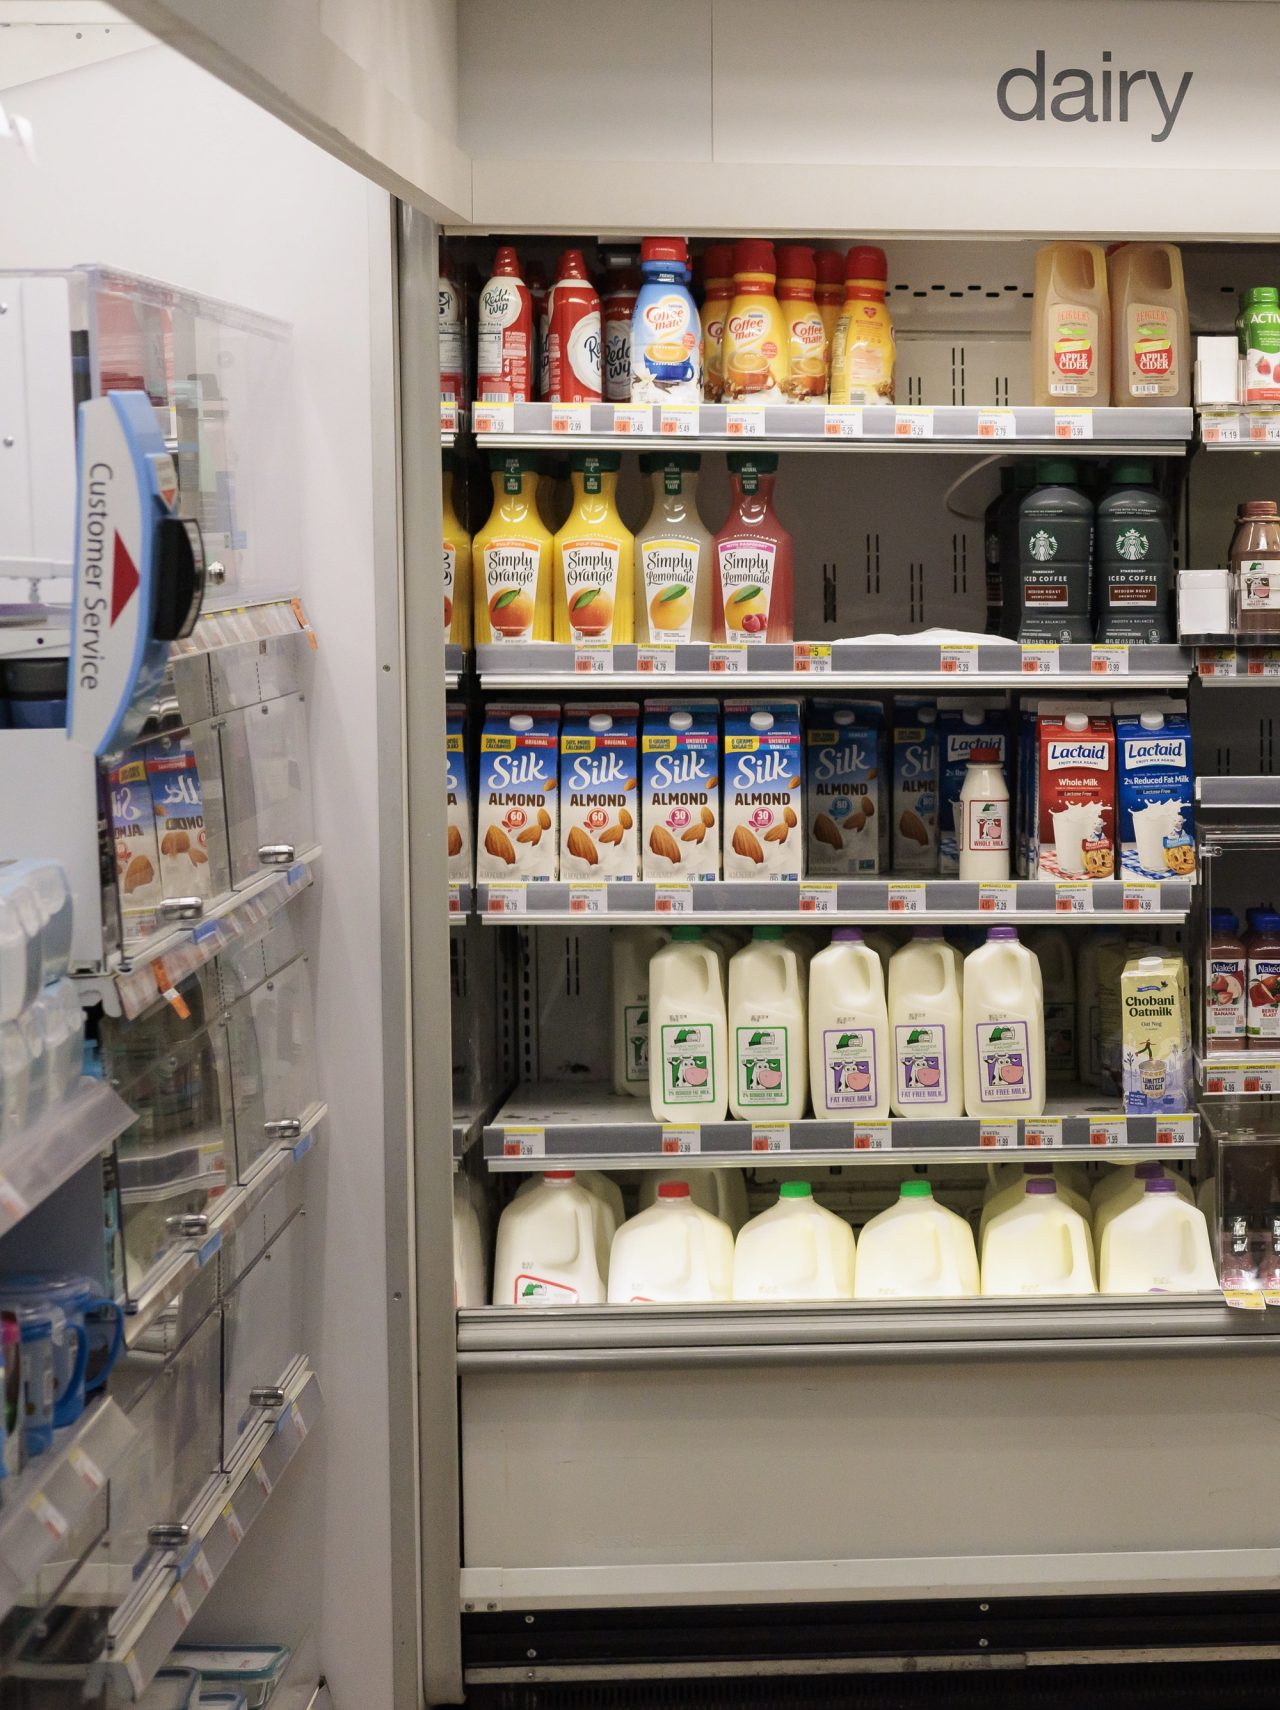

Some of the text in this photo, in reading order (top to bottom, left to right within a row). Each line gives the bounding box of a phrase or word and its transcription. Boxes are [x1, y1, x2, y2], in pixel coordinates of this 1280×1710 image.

[996, 50, 1194, 142] dairy
[729, 316, 764, 333] Coffee
[792, 321, 823, 338] Coffee
[1060, 353, 1087, 362] APPLE
[1140, 353, 1167, 362] APPLE
[1059, 361, 1089, 370] CIDER
[1140, 361, 1168, 370] CIDER
[488, 550, 533, 573] Simply
[568, 550, 613, 573] Simply
[647, 551, 693, 573] Simply
[724, 551, 769, 573] Simply
[80, 463, 113, 690] Customer Service
[487, 567, 534, 586] Orange
[567, 568, 614, 586] Orange
[645, 570, 694, 587] Lemonade
[722, 570, 770, 587] Lemonade
[1051, 745, 1105, 760] Lactaid
[1128, 742, 1182, 758] Lactaid
[814, 744, 870, 780] Silk
[901, 746, 937, 779] Sil
[487, 752, 548, 791] Silk
[568, 752, 628, 791] Silk
[650, 751, 710, 790] Silk
[732, 751, 793, 790] Silk
[902, 780, 936, 793] ALMO
[1058, 778, 1098, 786] Whole Milk
[1124, 777, 1133, 785] 2%
[1134, 776, 1163, 785] Reduced
[1174, 775, 1189, 783] Milk
[815, 783, 868, 796] ALMOND
[488, 792, 546, 807] ALMOND
[570, 793, 627, 807] ALMOND
[651, 792, 708, 806] ALMOND
[734, 792, 791, 806] ALMOND
[510, 811, 522, 820] 60
[592, 811, 604, 820] 60
[674, 810, 686, 819] 30
[757, 810, 769, 819] 30
[1125, 995, 1175, 1007] Chobani
[1129, 1007, 1172, 1017] Oatmilk
[901, 1090, 910, 1098] FAT
[912, 1090, 926, 1098] FREE
[996, 1088, 1009, 1096] FREE
